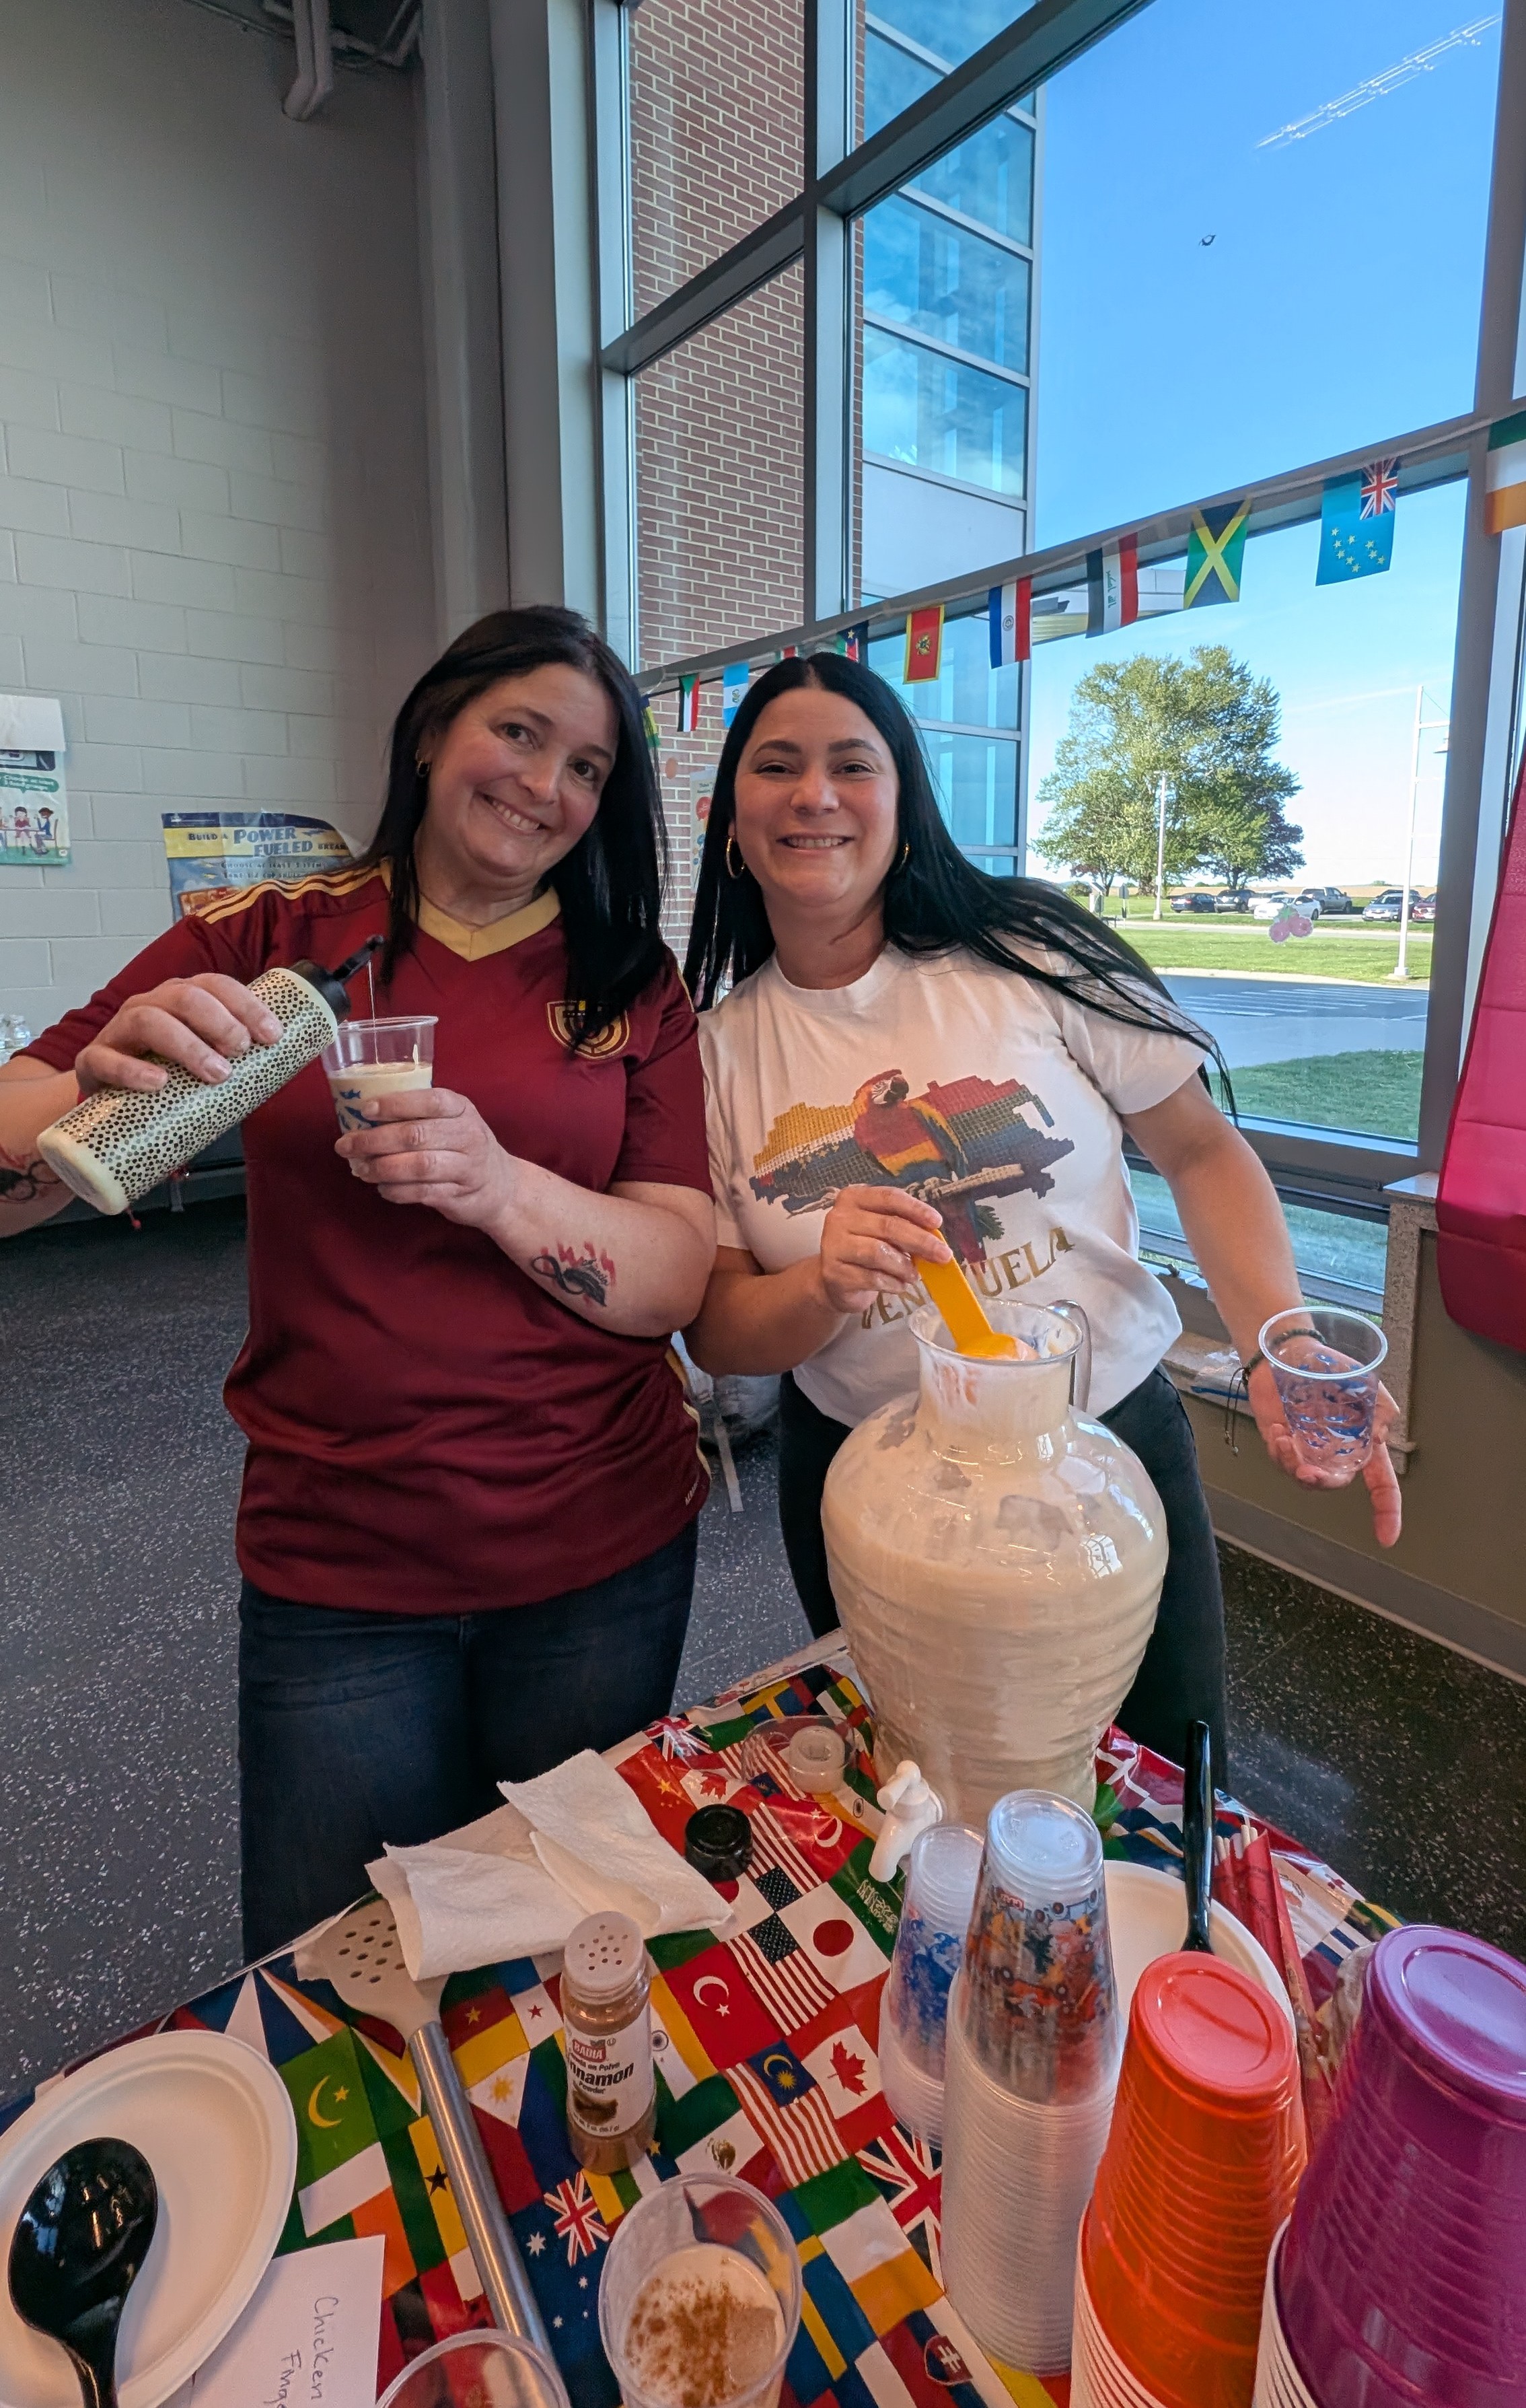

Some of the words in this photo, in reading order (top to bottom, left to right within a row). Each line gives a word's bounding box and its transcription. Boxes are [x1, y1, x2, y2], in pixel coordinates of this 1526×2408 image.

[233, 827, 297, 844] POWER
[253, 841, 313, 857] FUELED
[862, 1226, 1075, 1329] VENUELA
[574, 2043, 604, 2060] BADIA
[570, 2061, 634, 2087] nnamon
[312, 2296, 339, 2401] Chicken
